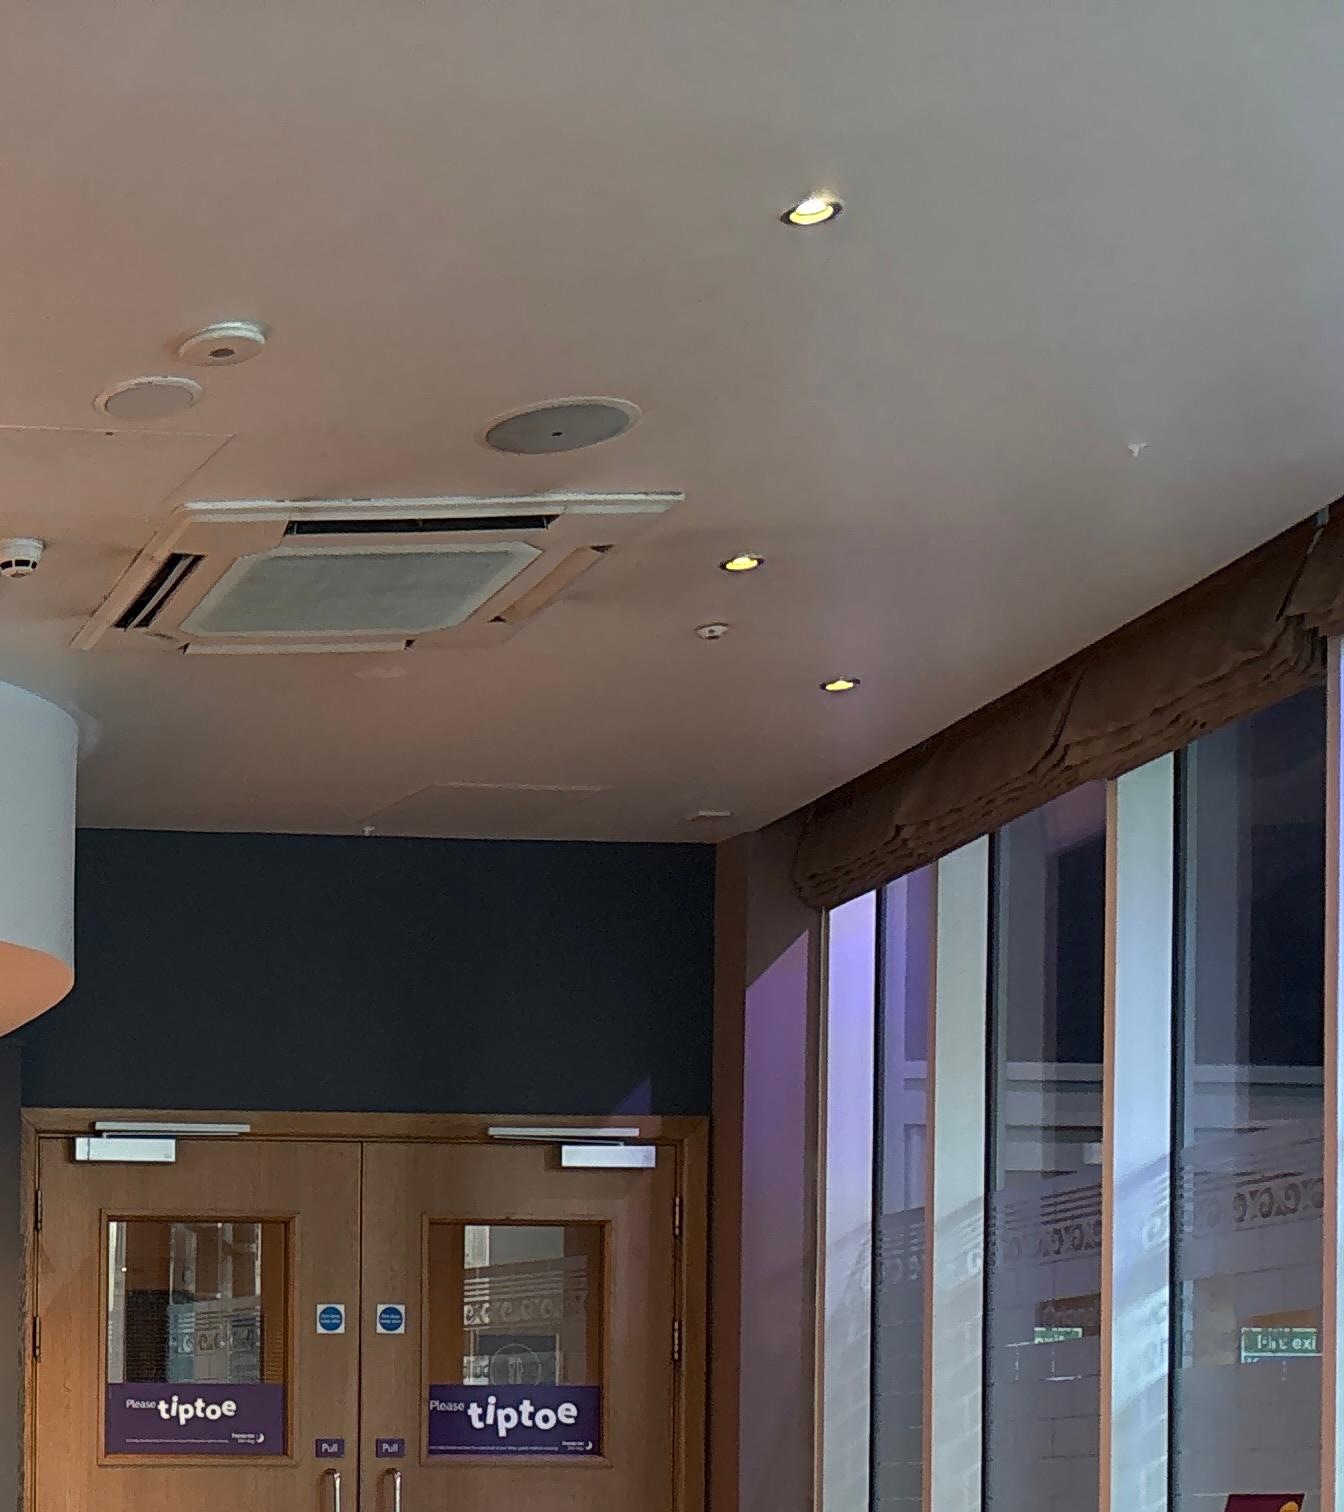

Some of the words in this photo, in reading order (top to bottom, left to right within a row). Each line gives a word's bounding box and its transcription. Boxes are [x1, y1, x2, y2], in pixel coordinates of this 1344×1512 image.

[125, 1399, 156, 1409] Please
[157, 1395, 237, 1426] tiptoe
[429, 1400, 465, 1412] Please
[467, 1395, 578, 1438] tiptoe
[321, 1443, 338, 1453] Pull
[382, 1443, 399, 1453] Pull
